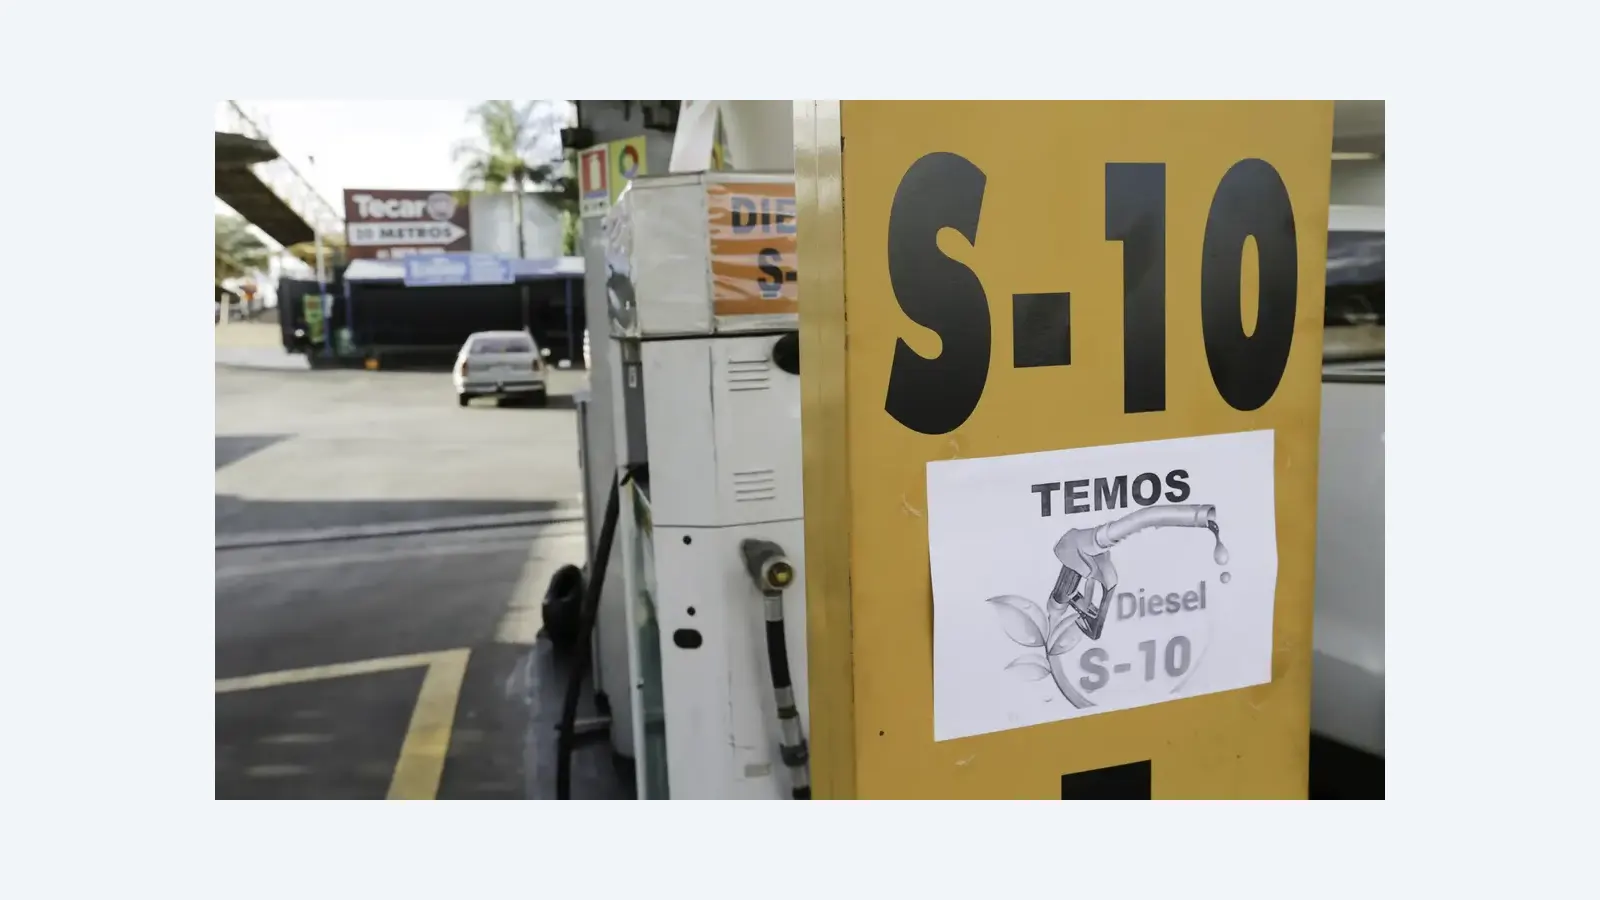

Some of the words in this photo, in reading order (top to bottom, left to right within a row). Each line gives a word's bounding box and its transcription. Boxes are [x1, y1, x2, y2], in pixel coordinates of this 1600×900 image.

[351, 193, 427, 219] Tecar
[379, 227, 453, 240] METROS
[885, 151, 1298, 435] S-10
[1031, 469, 1192, 517] TEMOS
[1116, 580, 1207, 622] Diesel
[1079, 635, 1193, 693] S-10
